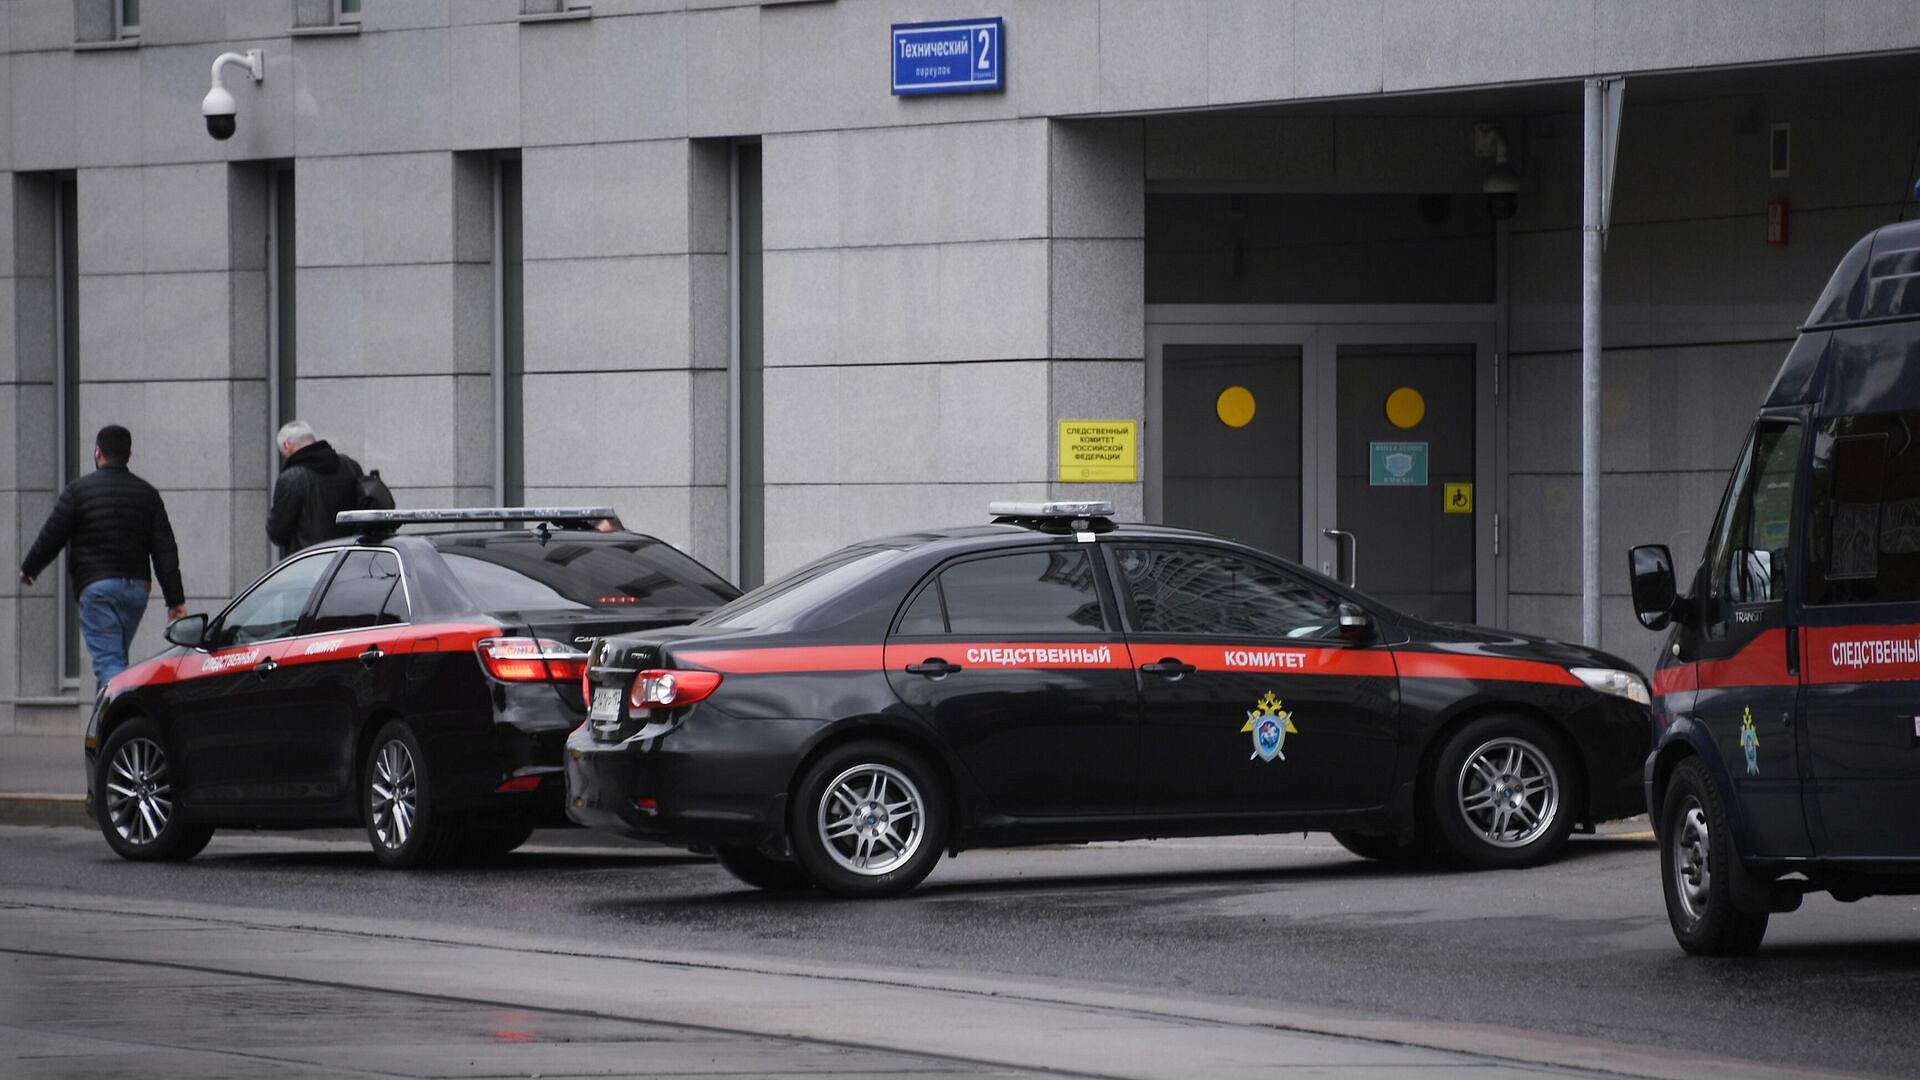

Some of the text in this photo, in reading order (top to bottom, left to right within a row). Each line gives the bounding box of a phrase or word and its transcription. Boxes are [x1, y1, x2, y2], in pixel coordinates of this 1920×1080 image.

[899, 36, 968, 59] Технический
[978, 29, 990, 69] 2
[1066, 427, 1129, 435] СЛЕДСТВЕННЫЙ
[1074, 453, 1120, 461] ФЕДЕРАЦИИ
[966, 646, 1306, 668] СЛЕДСТВЕННЫЙ КОМИТЕТ
[1832, 636, 1920, 669] СЛЕДСТВЕННЫ
